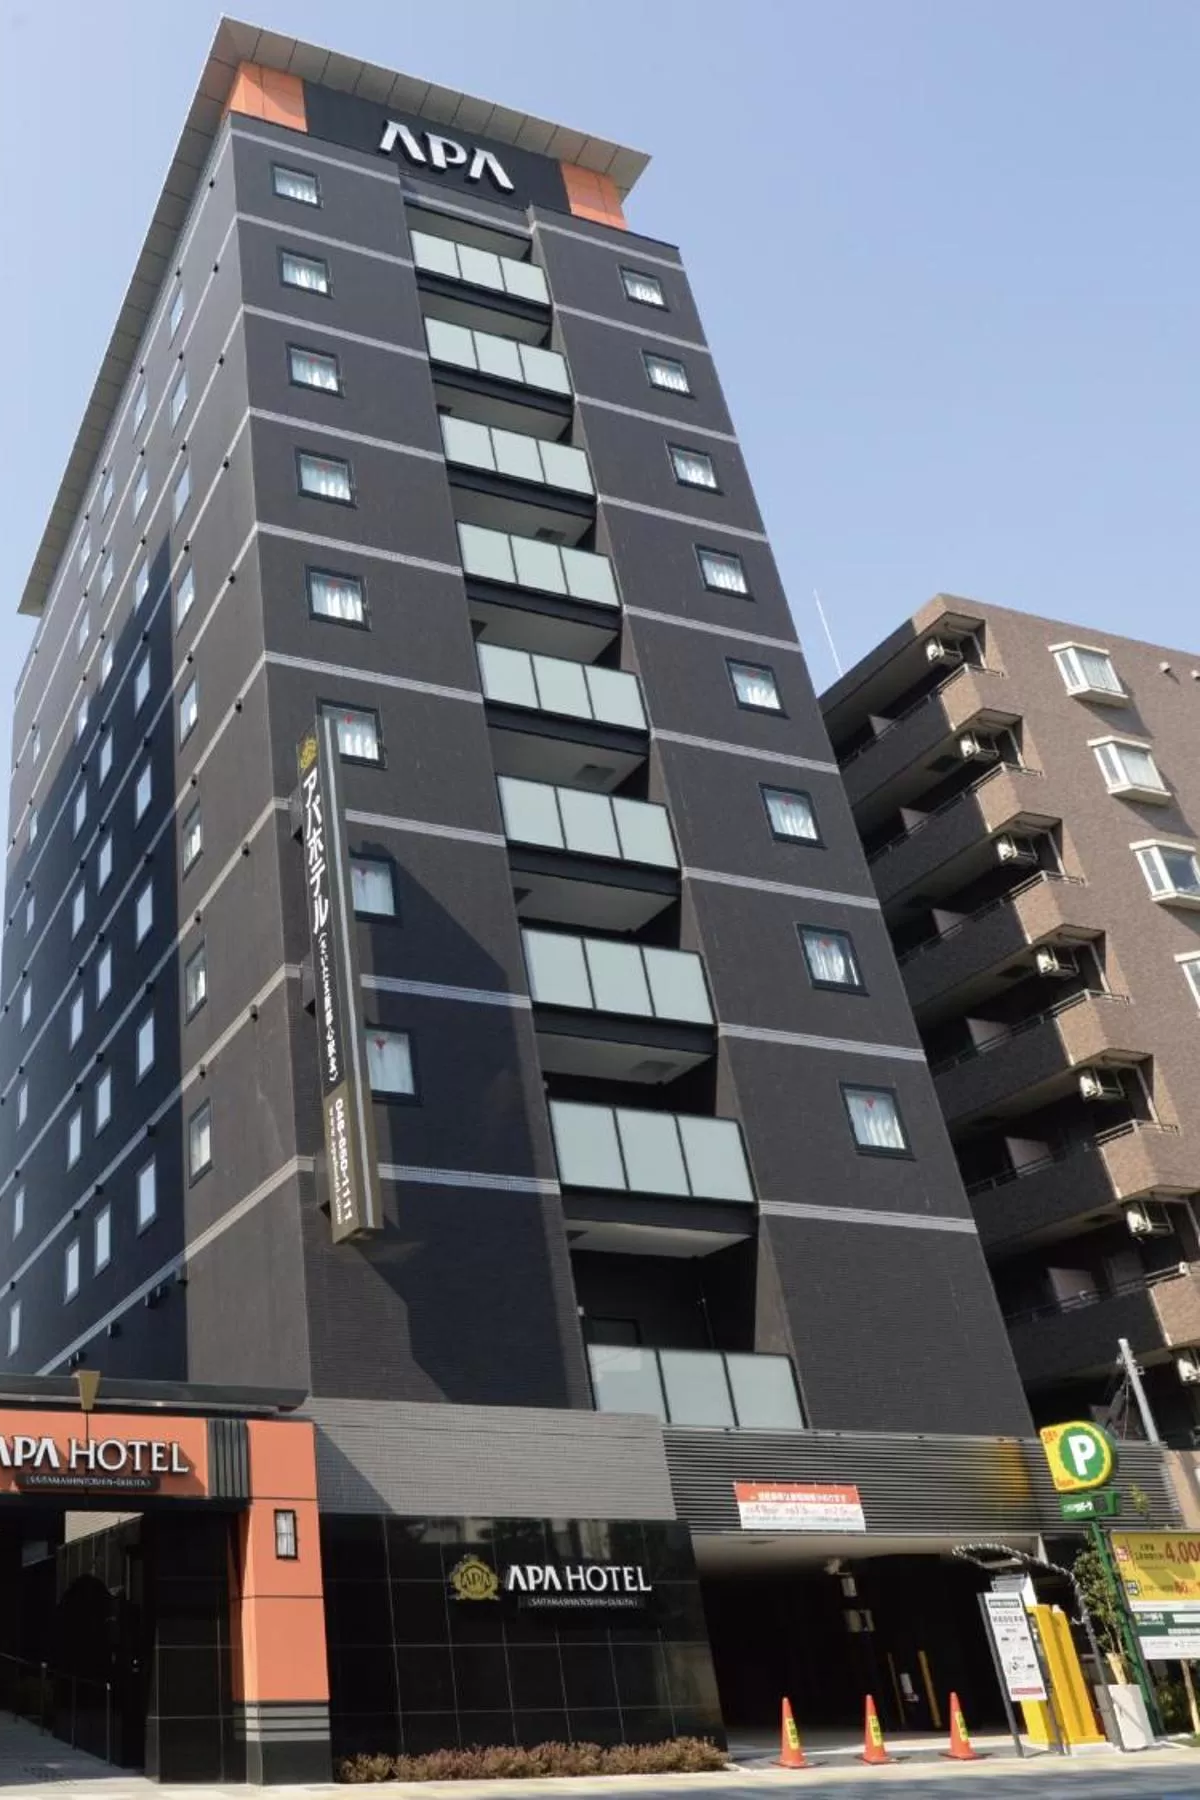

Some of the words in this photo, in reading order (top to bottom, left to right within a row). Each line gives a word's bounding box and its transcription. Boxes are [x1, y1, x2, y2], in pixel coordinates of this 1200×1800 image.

[379, 119, 515, 191] APA
[67, 1437, 189, 1474] HOTEL
[1068, 1434, 1097, 1476] P
[1165, 1541, 1200, 1564] 4,00
[507, 1565, 562, 1591] APA
[565, 1565, 652, 1592] HOTEL
